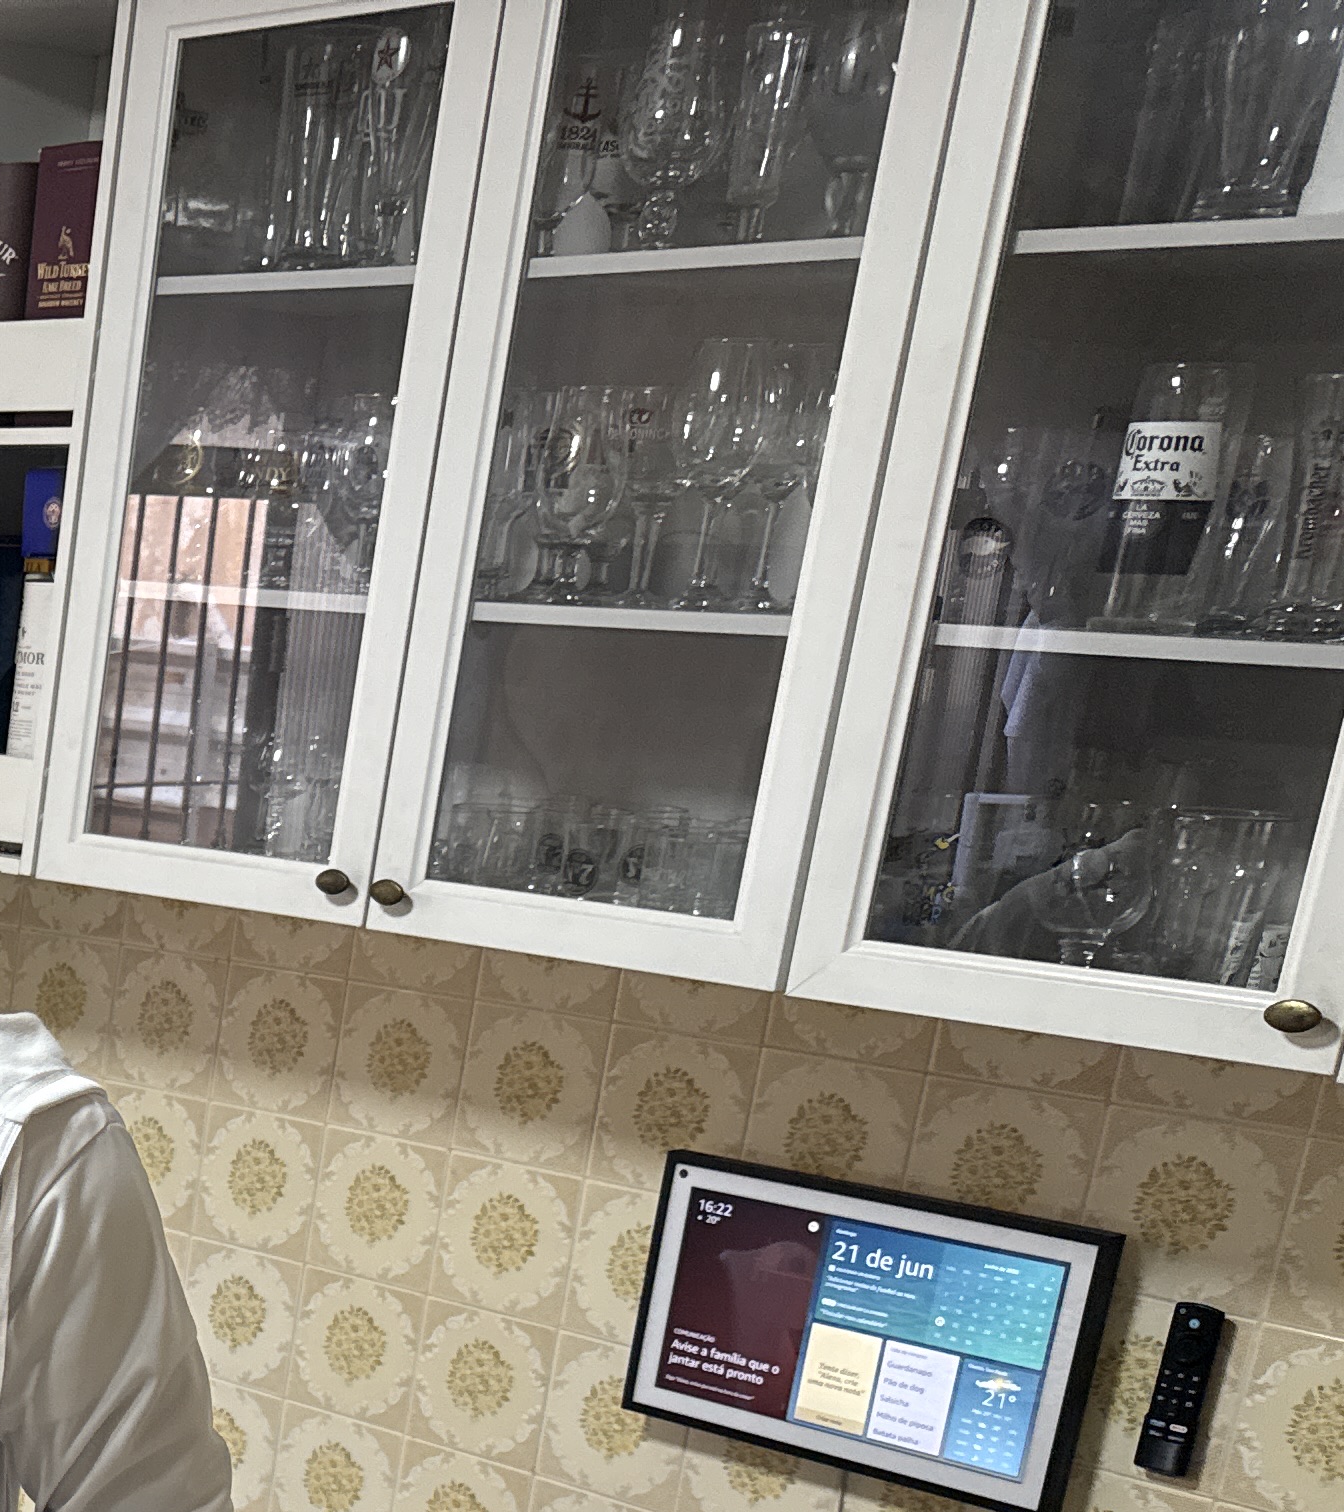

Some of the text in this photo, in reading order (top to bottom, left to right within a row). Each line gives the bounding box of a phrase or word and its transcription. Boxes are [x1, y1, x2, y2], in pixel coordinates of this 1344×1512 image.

[37, 262, 59, 279] WILD
[1125, 428, 1205, 456] Corona
[1132, 454, 1181, 472] Extra
[698, 1199, 733, 1218] 16:22
[831, 1241, 861, 1264] 21
[865, 1248, 893, 1271] de
[895, 1254, 935, 1280] jun
[670, 1338, 780, 1375] Avise a família que o
[667, 1352, 764, 1386] jantar está pronto
[887, 1360, 933, 1378] Guardanapo
[900, 1380, 908, 1389] de
[879, 1393, 910, 1408] Salsicha
[981, 1389, 1017, 1409] 21°
[876, 1410, 896, 1423] Milho
[897, 1416, 907, 1425] de
[872, 1427, 896, 1440] Batata
